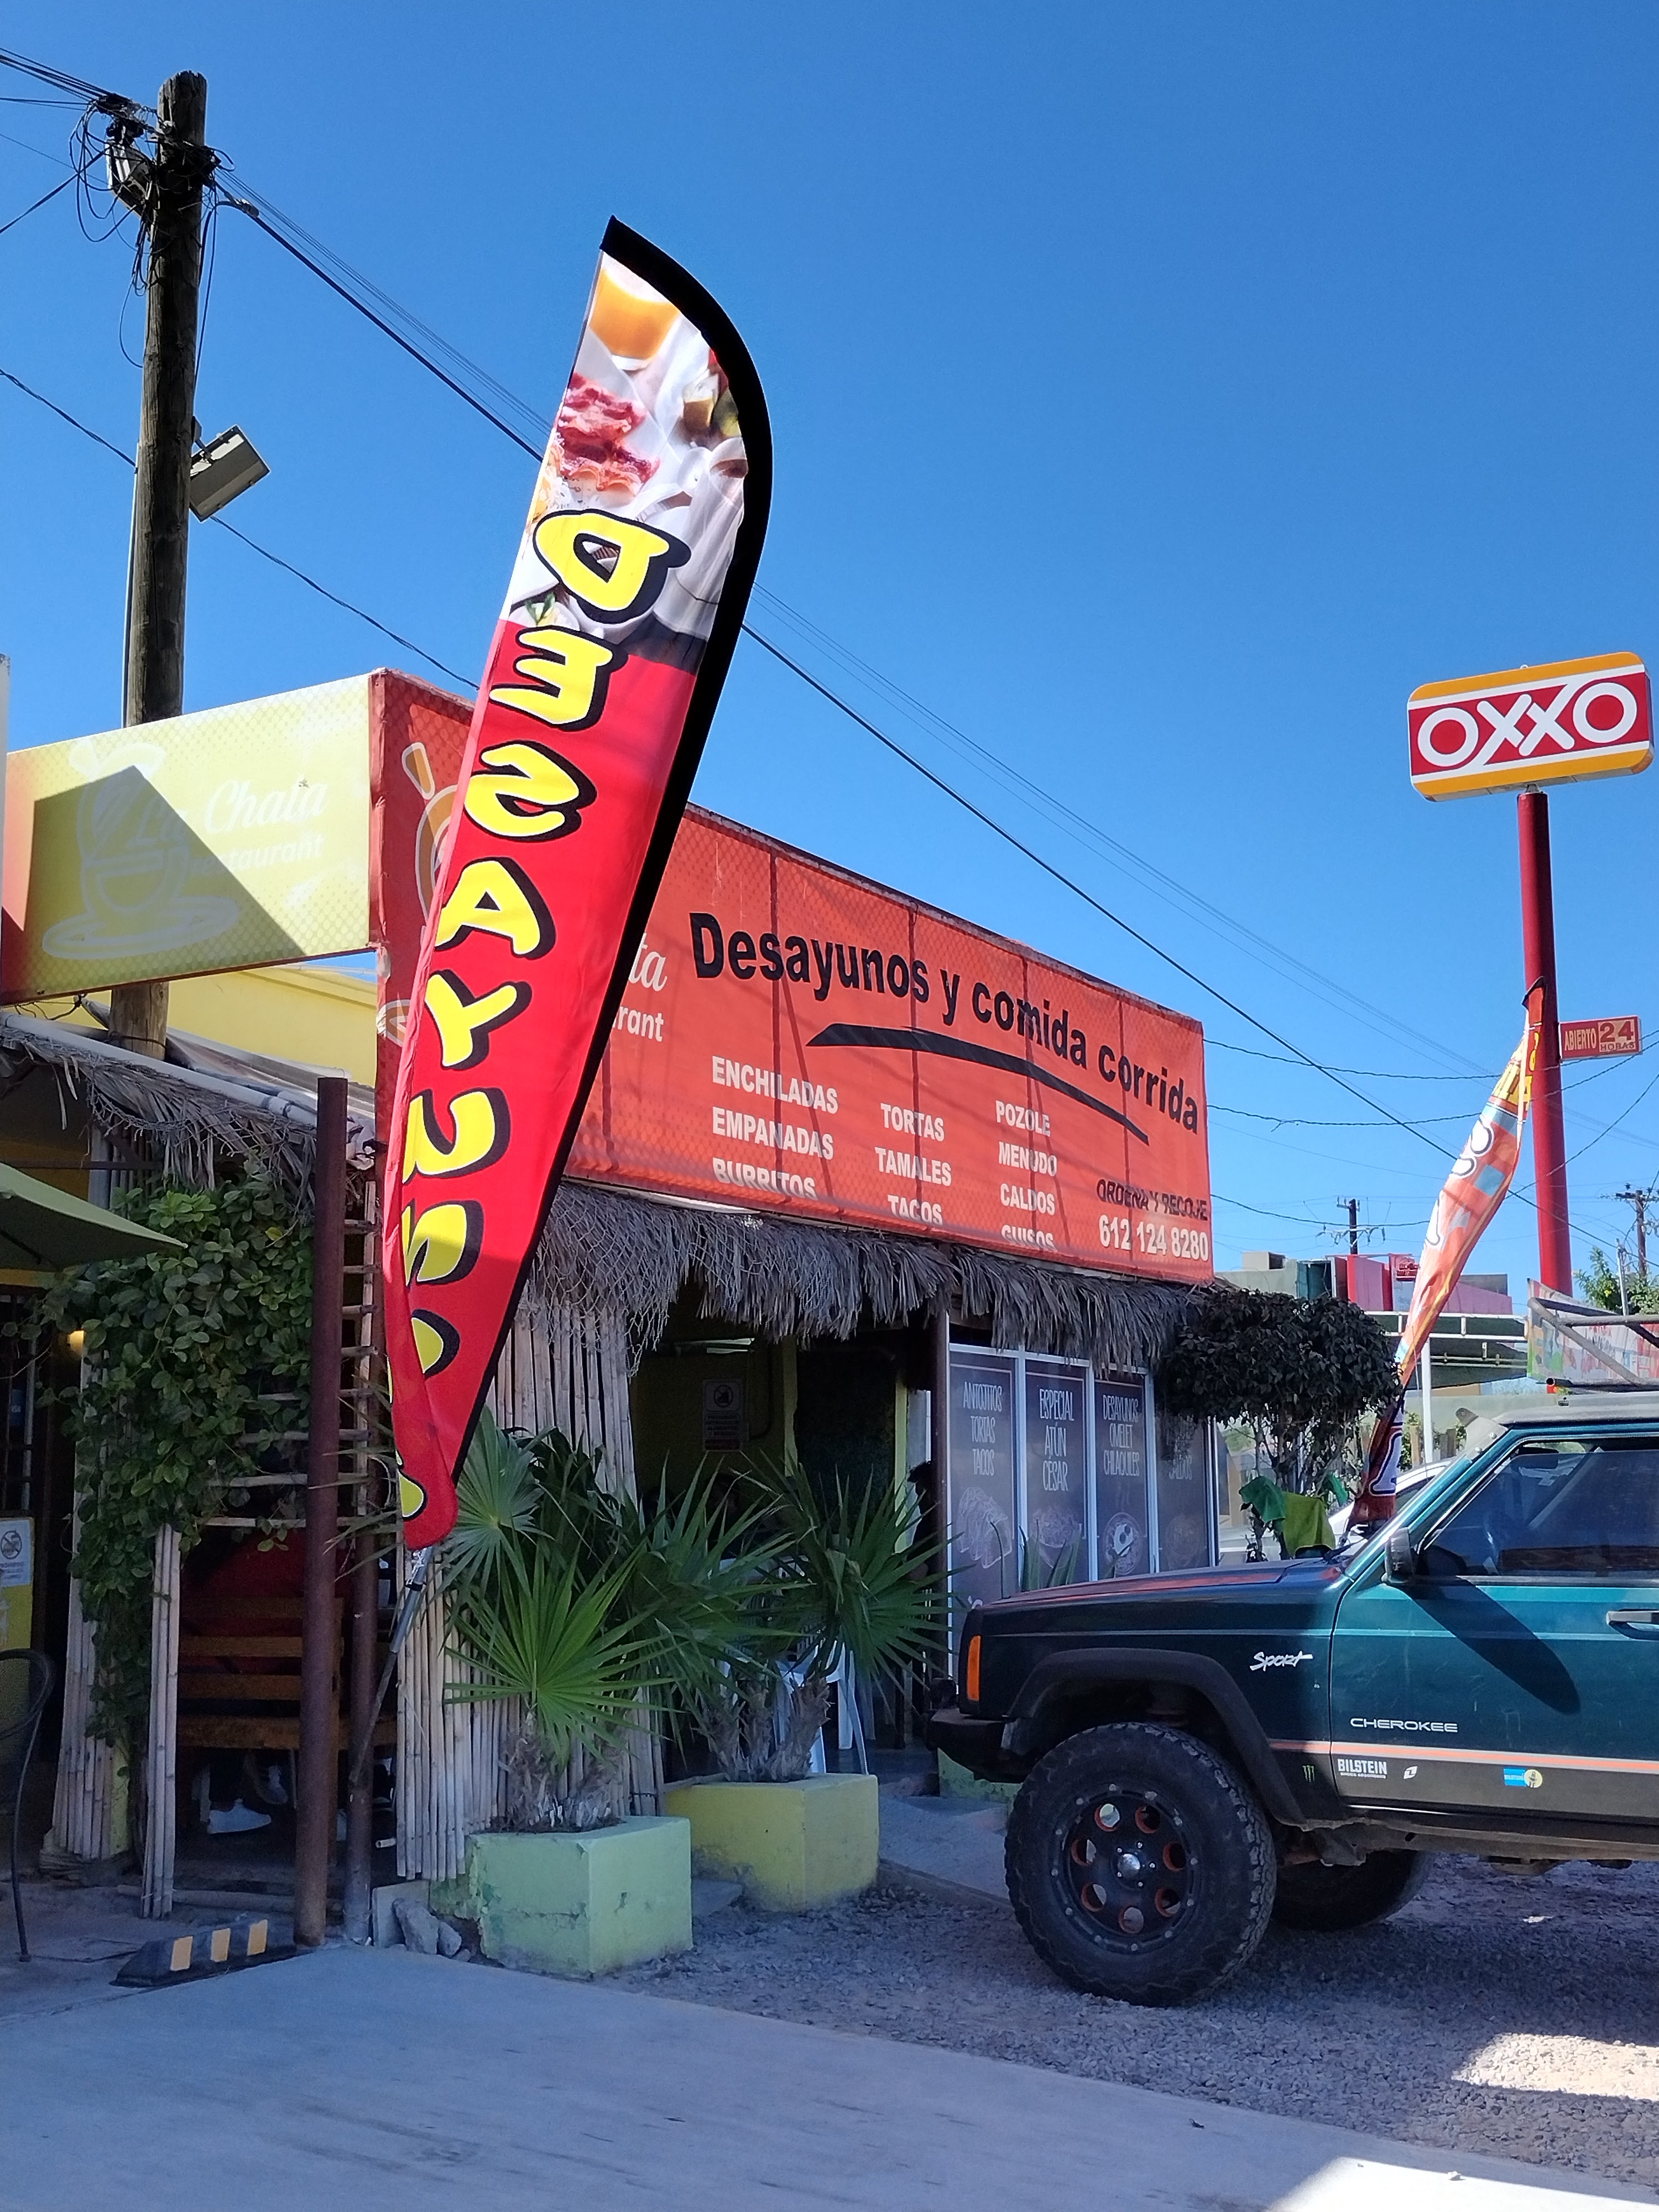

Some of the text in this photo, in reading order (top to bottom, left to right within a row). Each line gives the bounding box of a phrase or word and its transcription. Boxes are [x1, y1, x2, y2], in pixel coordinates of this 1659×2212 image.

[1417, 682, 1637, 767] OXXO
[690, 912, 930, 1002] Desayunos
[940, 968, 961, 1026] y
[972, 982, 1087, 1070] comida
[1098, 1045, 1198, 1135] corrida
[1564, 1020, 1634, 1051] ABIERTO 24
[1600, 1042, 1635, 1051] HORAS
[712, 1055, 839, 1114] ENCHILADAS
[712, 1107, 834, 1161] EMPANADAS
[880, 1103, 945, 1142] TORTAS
[995, 1100, 1051, 1137] POZOLE
[874, 1146, 952, 1187] TAMALES
[998, 1141, 1057, 1177] MENUDO
[712, 1157, 818, 1201] BURRITOS
[888, 1194, 943, 1226] TACOS
[1000, 1183, 1056, 1215] CALDOS
[1097, 1178, 1208, 1221] ORDENA Y RECOJE
[1098, 1214, 1209, 1262] 612 124 8280
[963, 1381, 1003, 1412] ANTOJITOS
[1039, 1388, 1074, 1421] ESPECIAL
[1102, 1394, 1139, 1423] DESAYUNOS
[971, 1415, 995, 1444] TORTAS
[1045, 1422, 1067, 1457] ATÚN
[1109, 1423, 1133, 1449] OMELET
[972, 1448, 995, 1477] TACOS
[1103, 1449, 1140, 1477] CHILAQUILES
[1350, 1717, 1458, 1733] CHEROKEE
[1337, 1759, 1387, 1775] BILSTEIN
